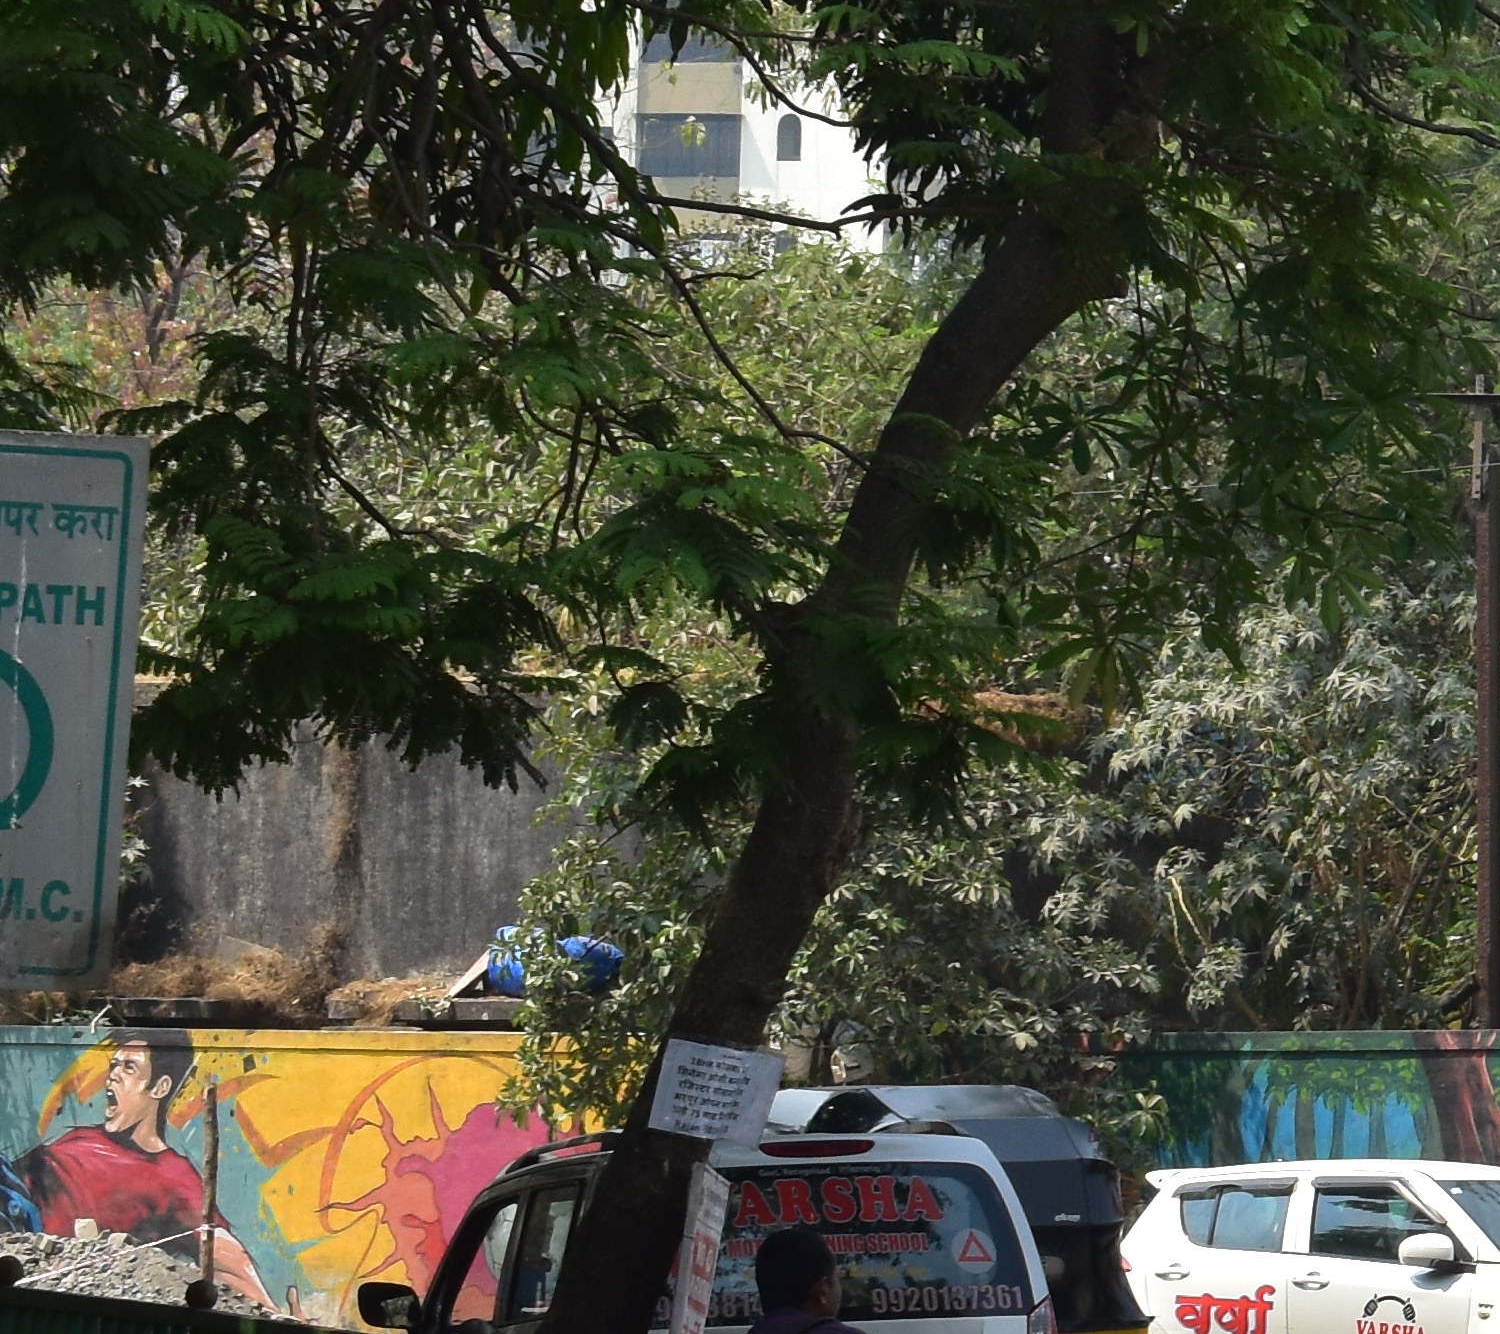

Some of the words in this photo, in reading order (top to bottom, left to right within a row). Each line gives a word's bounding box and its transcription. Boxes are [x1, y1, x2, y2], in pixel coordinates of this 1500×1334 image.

[51, 503, 118, 541] करा
[0, 582, 106, 626] PATH
[730, 1176, 945, 1227] ARSHA
[866, 1232, 929, 1254] SCHOOL
[871, 1285, 1024, 1314] 9920137361
